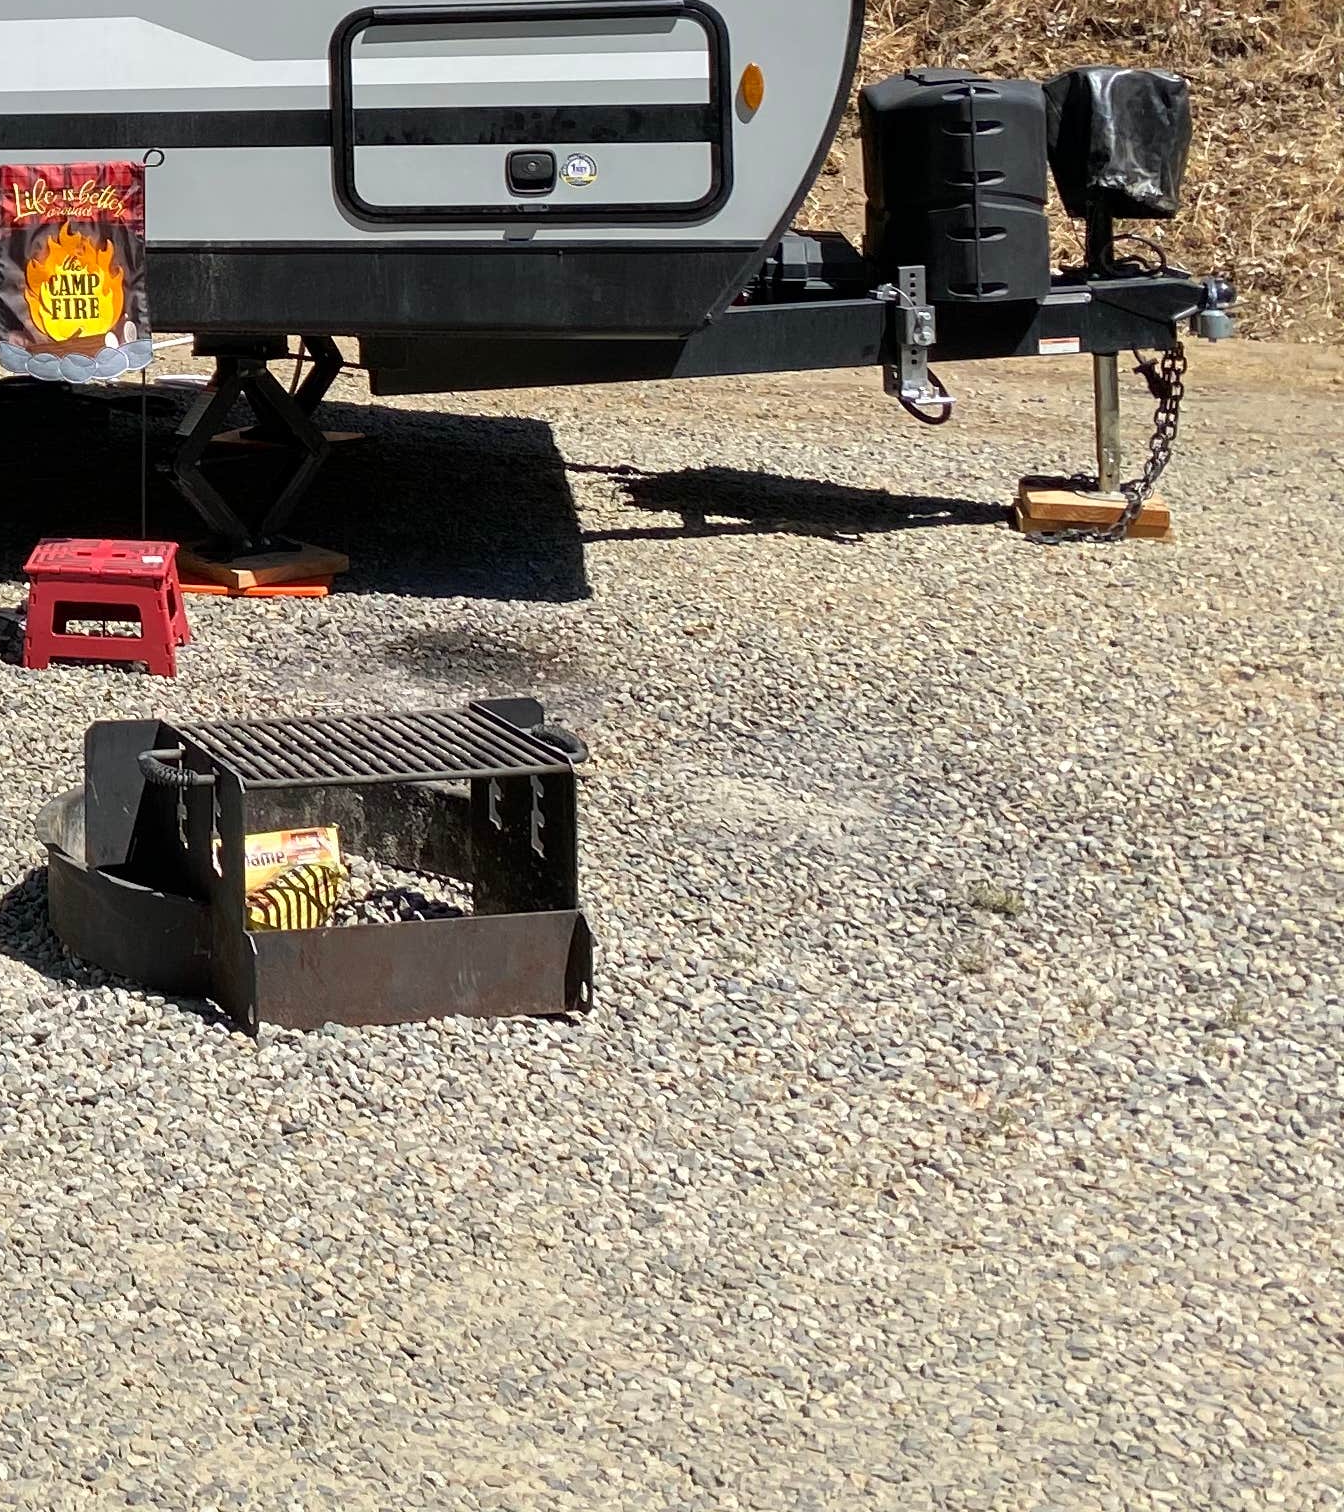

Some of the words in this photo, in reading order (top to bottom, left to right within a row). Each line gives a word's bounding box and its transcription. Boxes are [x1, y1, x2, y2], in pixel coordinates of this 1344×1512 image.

[12, 178, 58, 222] Life
[78, 179, 127, 217] better
[47, 205, 94, 218] around
[62, 255, 82, 272] the
[48, 273, 100, 297] CAMP
[51, 298, 100, 320] FIRE
